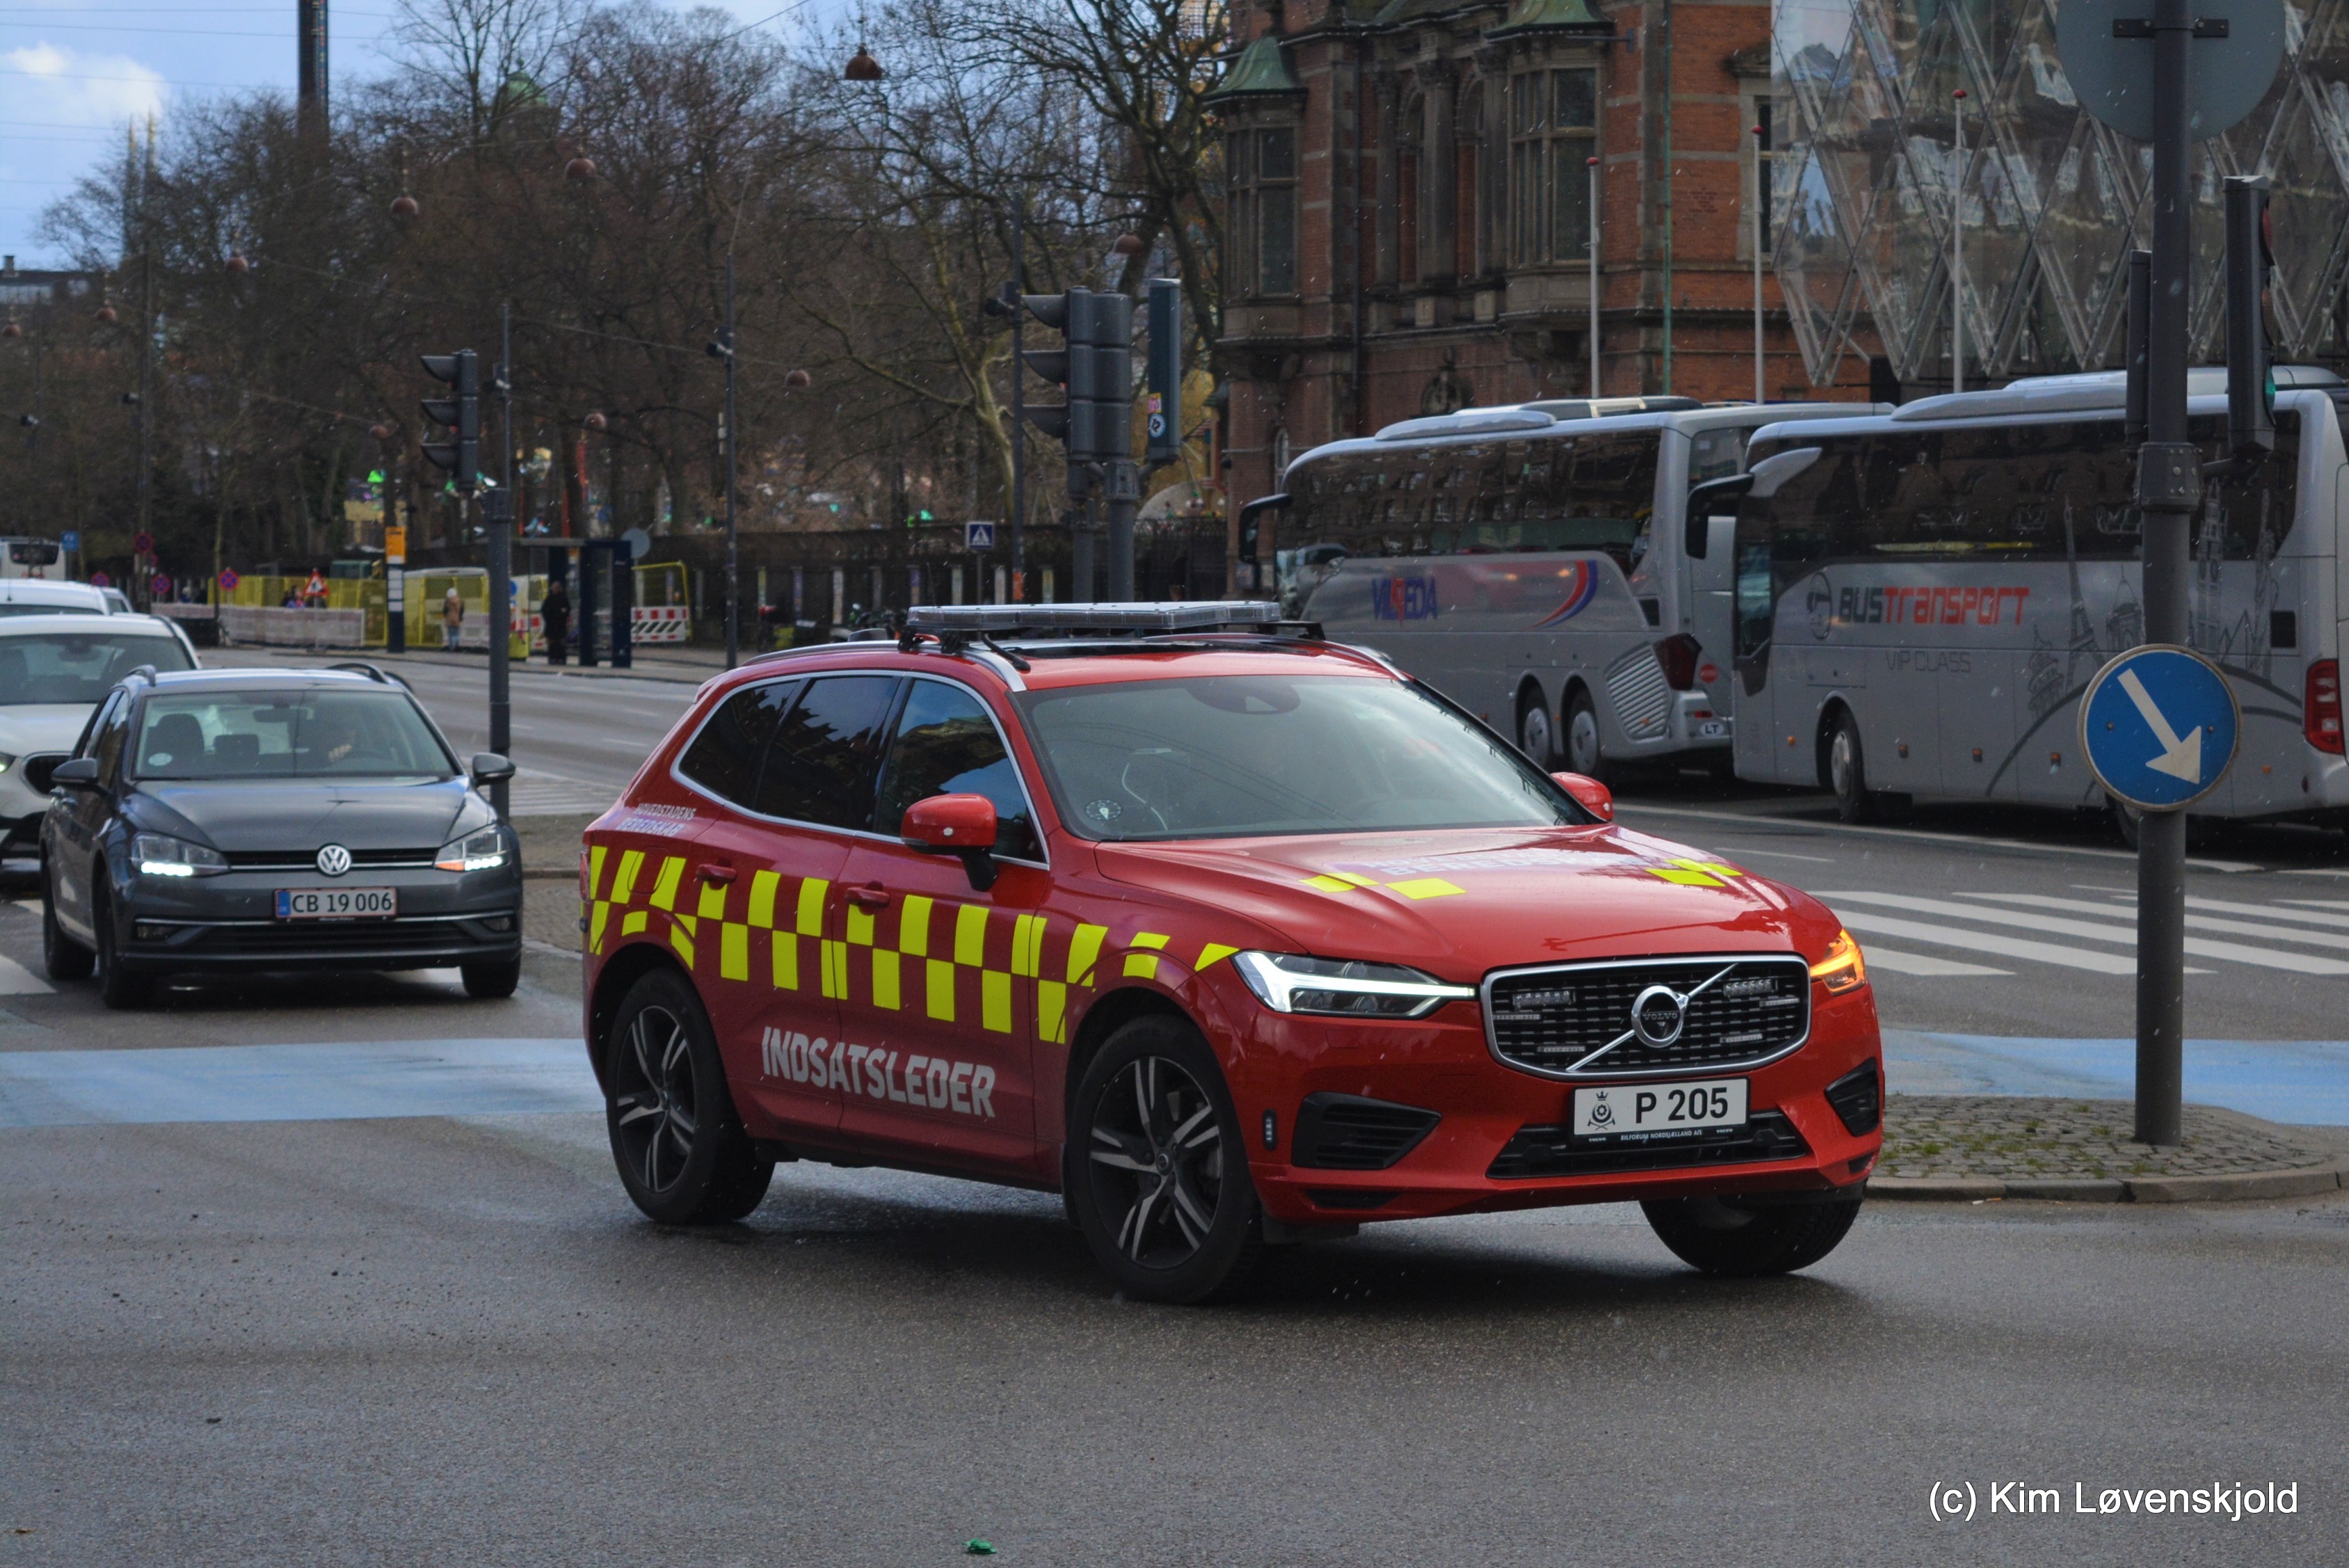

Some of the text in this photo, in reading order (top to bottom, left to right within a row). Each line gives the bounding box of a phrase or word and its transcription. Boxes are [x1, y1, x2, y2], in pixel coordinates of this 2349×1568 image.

[1885, 650, 1971, 673] VIP CLASS
[1705, 724, 1719, 735] LT
[632, 803, 697, 821] HOVEDSTADENS
[615, 817, 685, 837] BEREDSKAB
[291, 893, 392, 913] CB 19 006
[1642, 1013, 1678, 1021] VOLVO
[762, 1026, 995, 1118] INDSATSLEDER
[1635, 1087, 1729, 1124] P 205
[1650, 1130, 1692, 1139] NORDSJÆLLAND
